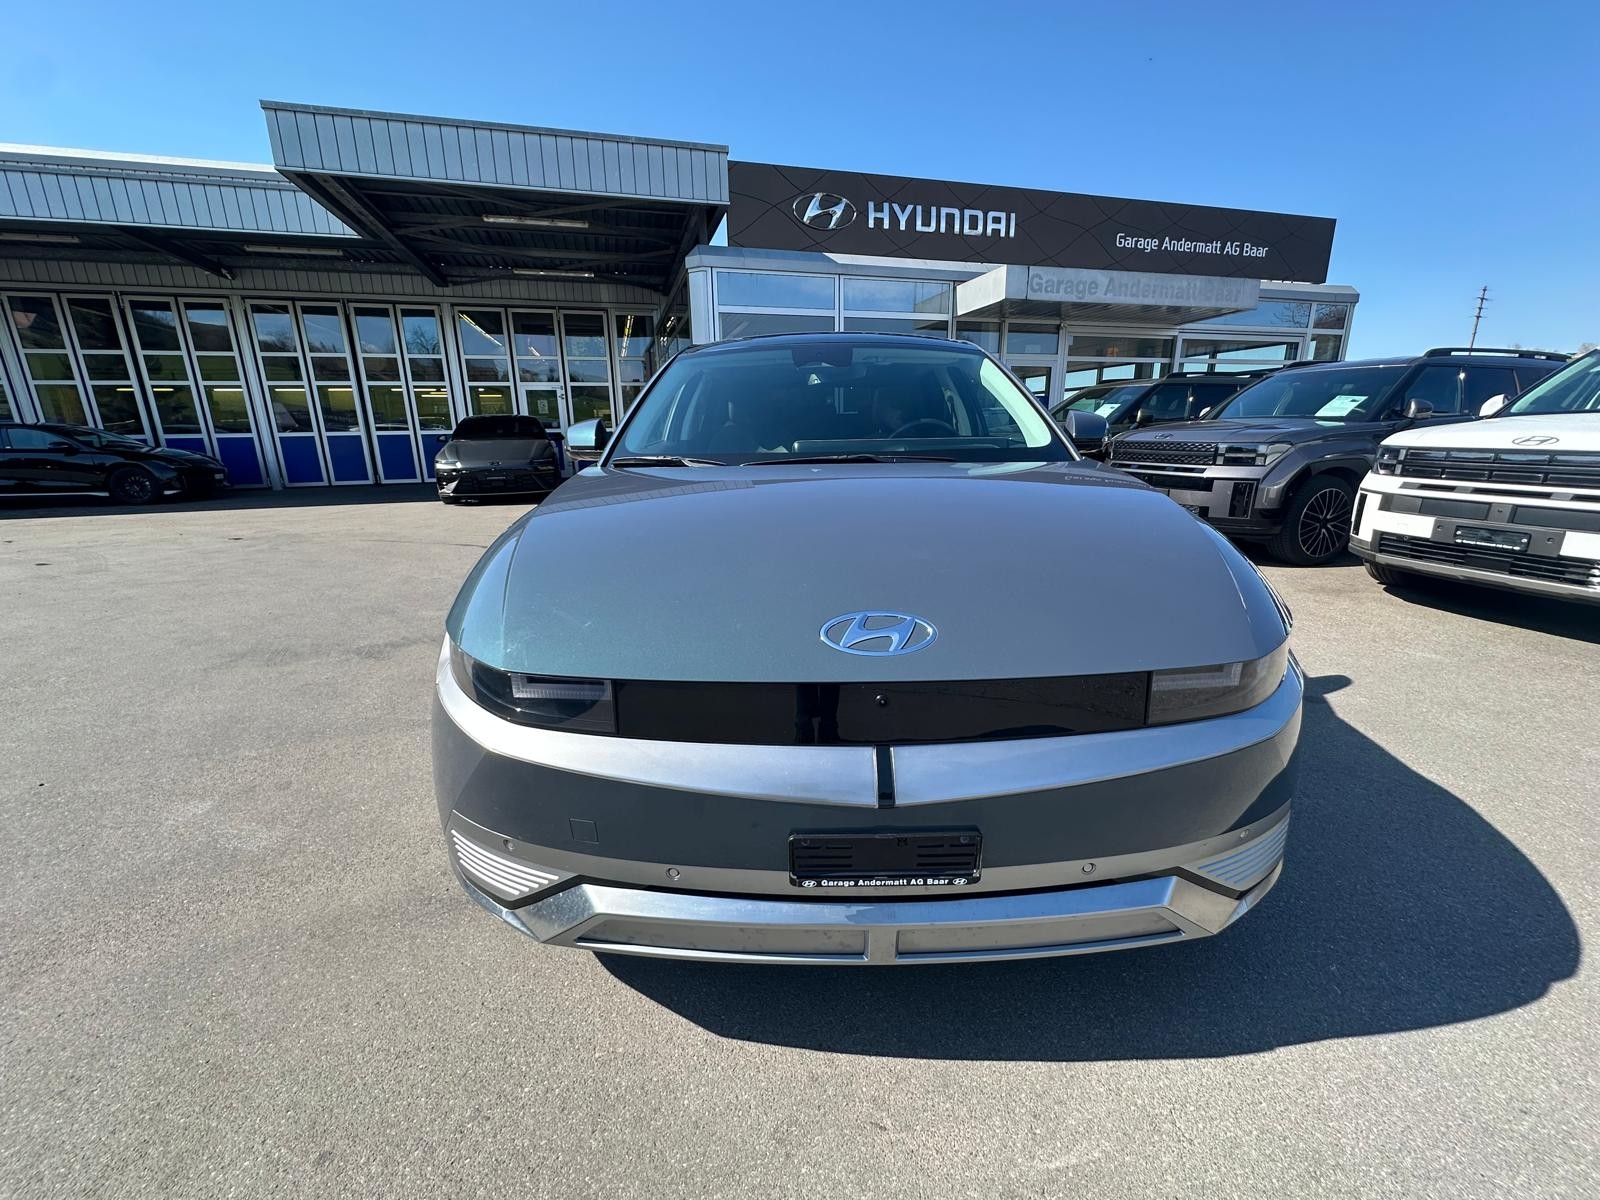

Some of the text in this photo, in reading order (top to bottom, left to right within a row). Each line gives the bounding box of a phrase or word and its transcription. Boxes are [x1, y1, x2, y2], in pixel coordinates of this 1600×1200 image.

[868, 201, 1016, 238] HYUNDAI
[1116, 233, 1269, 257] Garage Andermatt AG Baar
[1030, 273, 1098, 299] Garage
[1104, 277, 1197, 301] Andermatt
[821, 879, 855, 887] Garage
